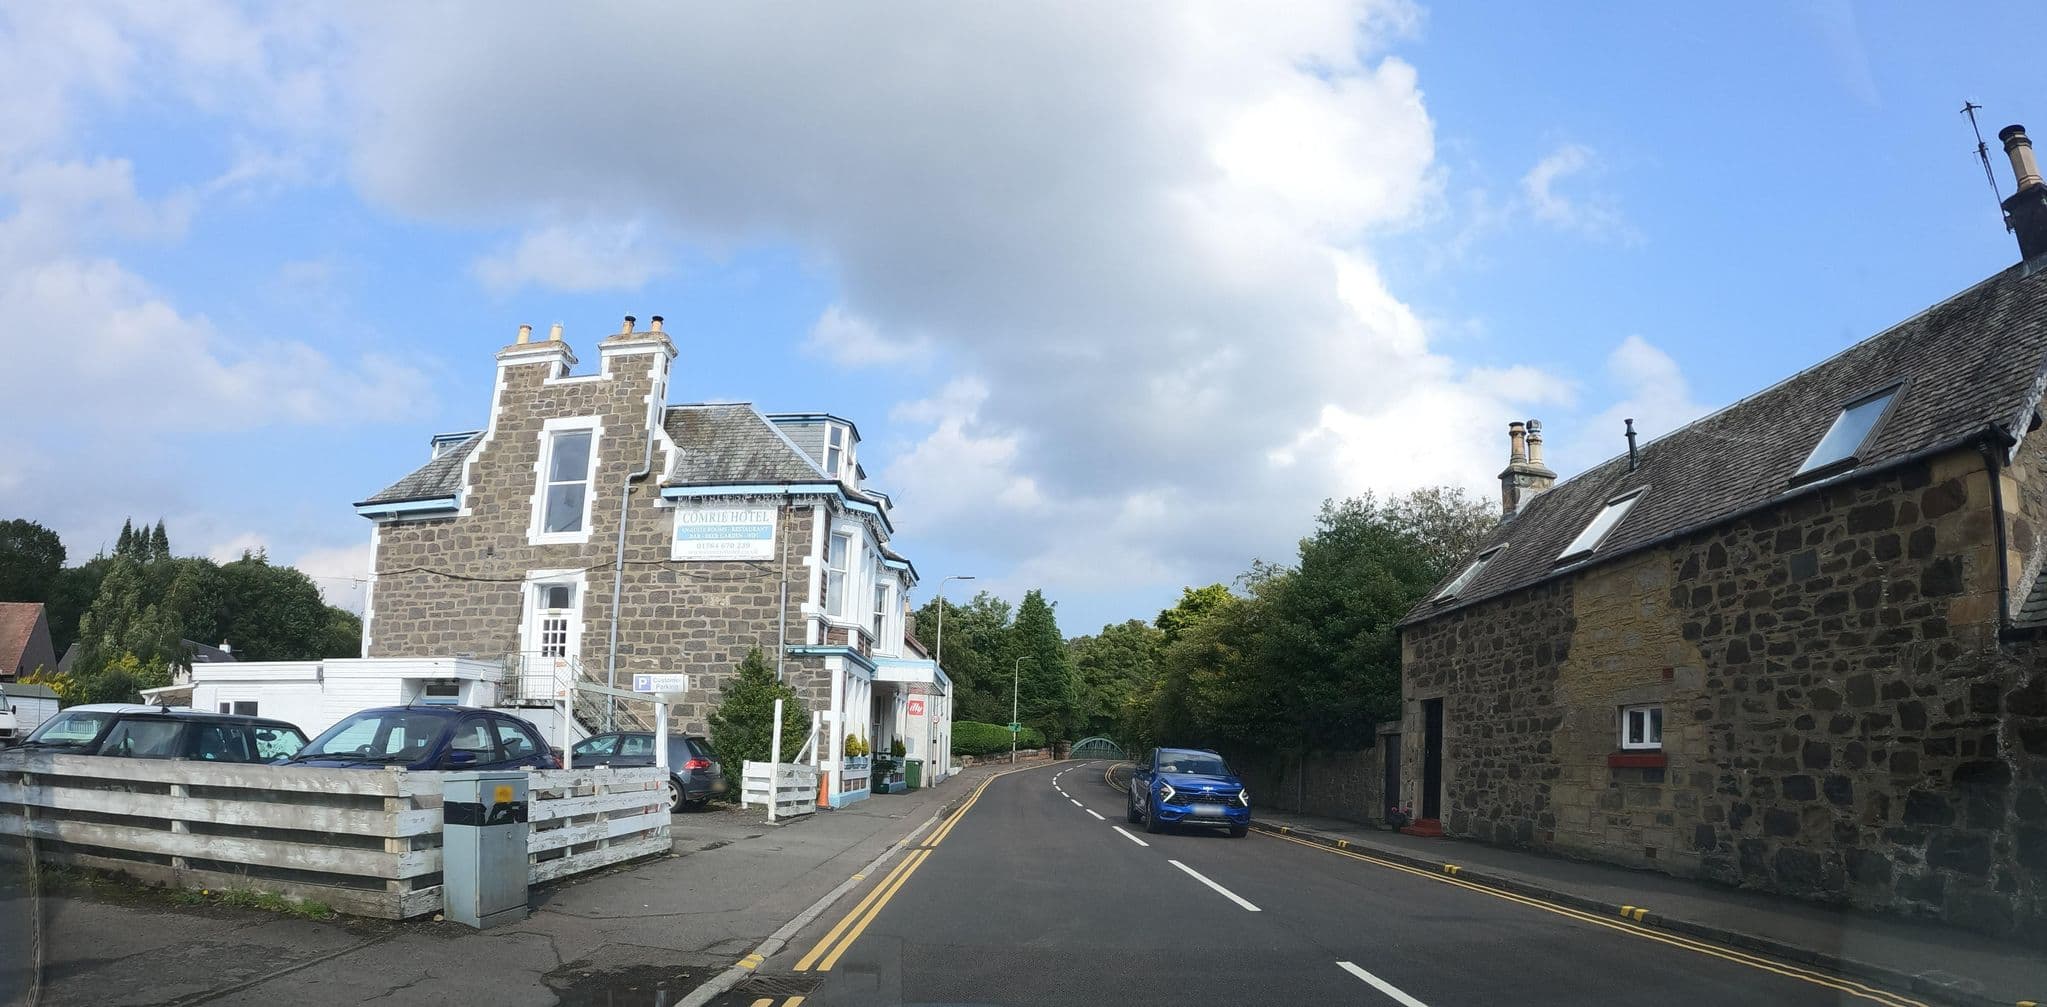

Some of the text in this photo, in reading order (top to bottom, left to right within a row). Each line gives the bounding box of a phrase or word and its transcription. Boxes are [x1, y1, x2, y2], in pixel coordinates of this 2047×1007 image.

[682, 511, 769, 523] COMRIE HOTEL
[638, 676, 648, 689] P
